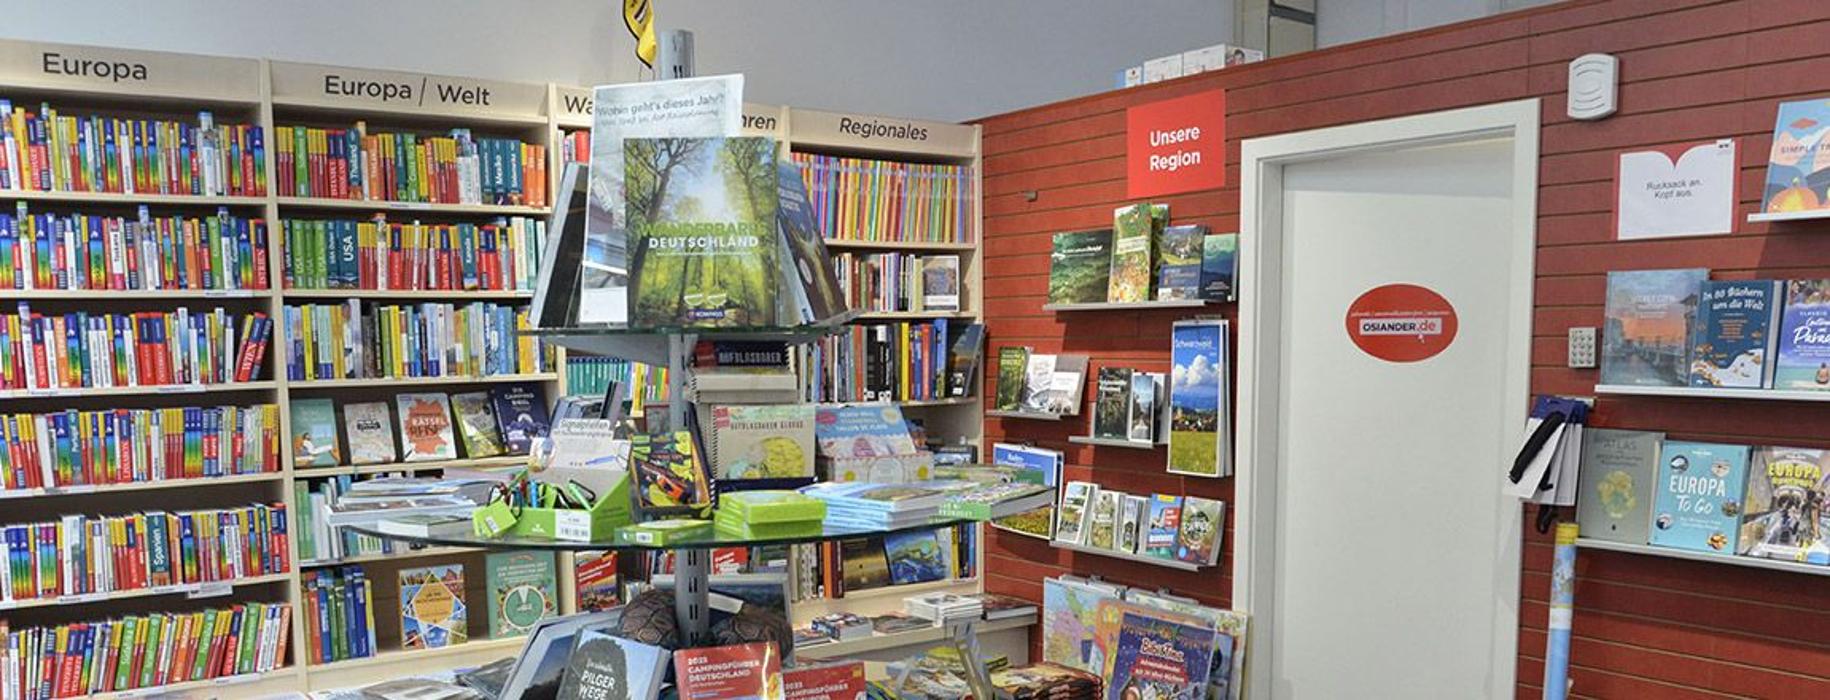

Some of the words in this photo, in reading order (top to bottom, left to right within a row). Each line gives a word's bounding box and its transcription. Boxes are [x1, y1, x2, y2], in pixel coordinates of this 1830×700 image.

[43, 52, 148, 82] Europa
[324, 75, 412, 101] Europa
[437, 84, 490, 105] Welt
[662, 99, 694, 109] dieses
[840, 117, 928, 140] Regionales
[1150, 126, 1200, 147] Unsere
[1781, 144, 1816, 154] SIMPLE
[349, 144, 358, 179] Thailand
[494, 155, 502, 184] Mexiko
[1150, 150, 1200, 171] Region
[1646, 179, 1686, 190] Rucksack
[1655, 191, 1674, 200] Kopf
[343, 235, 354, 261] USA
[648, 236, 759, 249] DEUTSCHLAND
[1727, 286, 1764, 297] Büchern
[1712, 302, 1727, 310] um
[1729, 300, 1742, 309] die
[1744, 300, 1764, 310] Welt
[1363, 319, 1436, 332] OSIANDER.de
[241, 343, 258, 370] WIEN
[1604, 439, 1637, 450] ATLAS
[122, 440, 131, 478] LISSABON
[1767, 462, 1822, 480] EUROPA
[1669, 475, 1726, 497] EUROPA
[1677, 495, 1692, 512] To
[1694, 500, 1713, 513] Go
[152, 529, 164, 565] Spanien
[688, 660, 760, 674] CAMPINGFÜHRER
[580, 670, 616, 690] PILGER
[688, 671, 751, 682] DEUTSCHLAND
[578, 683, 609, 700] WEGE
